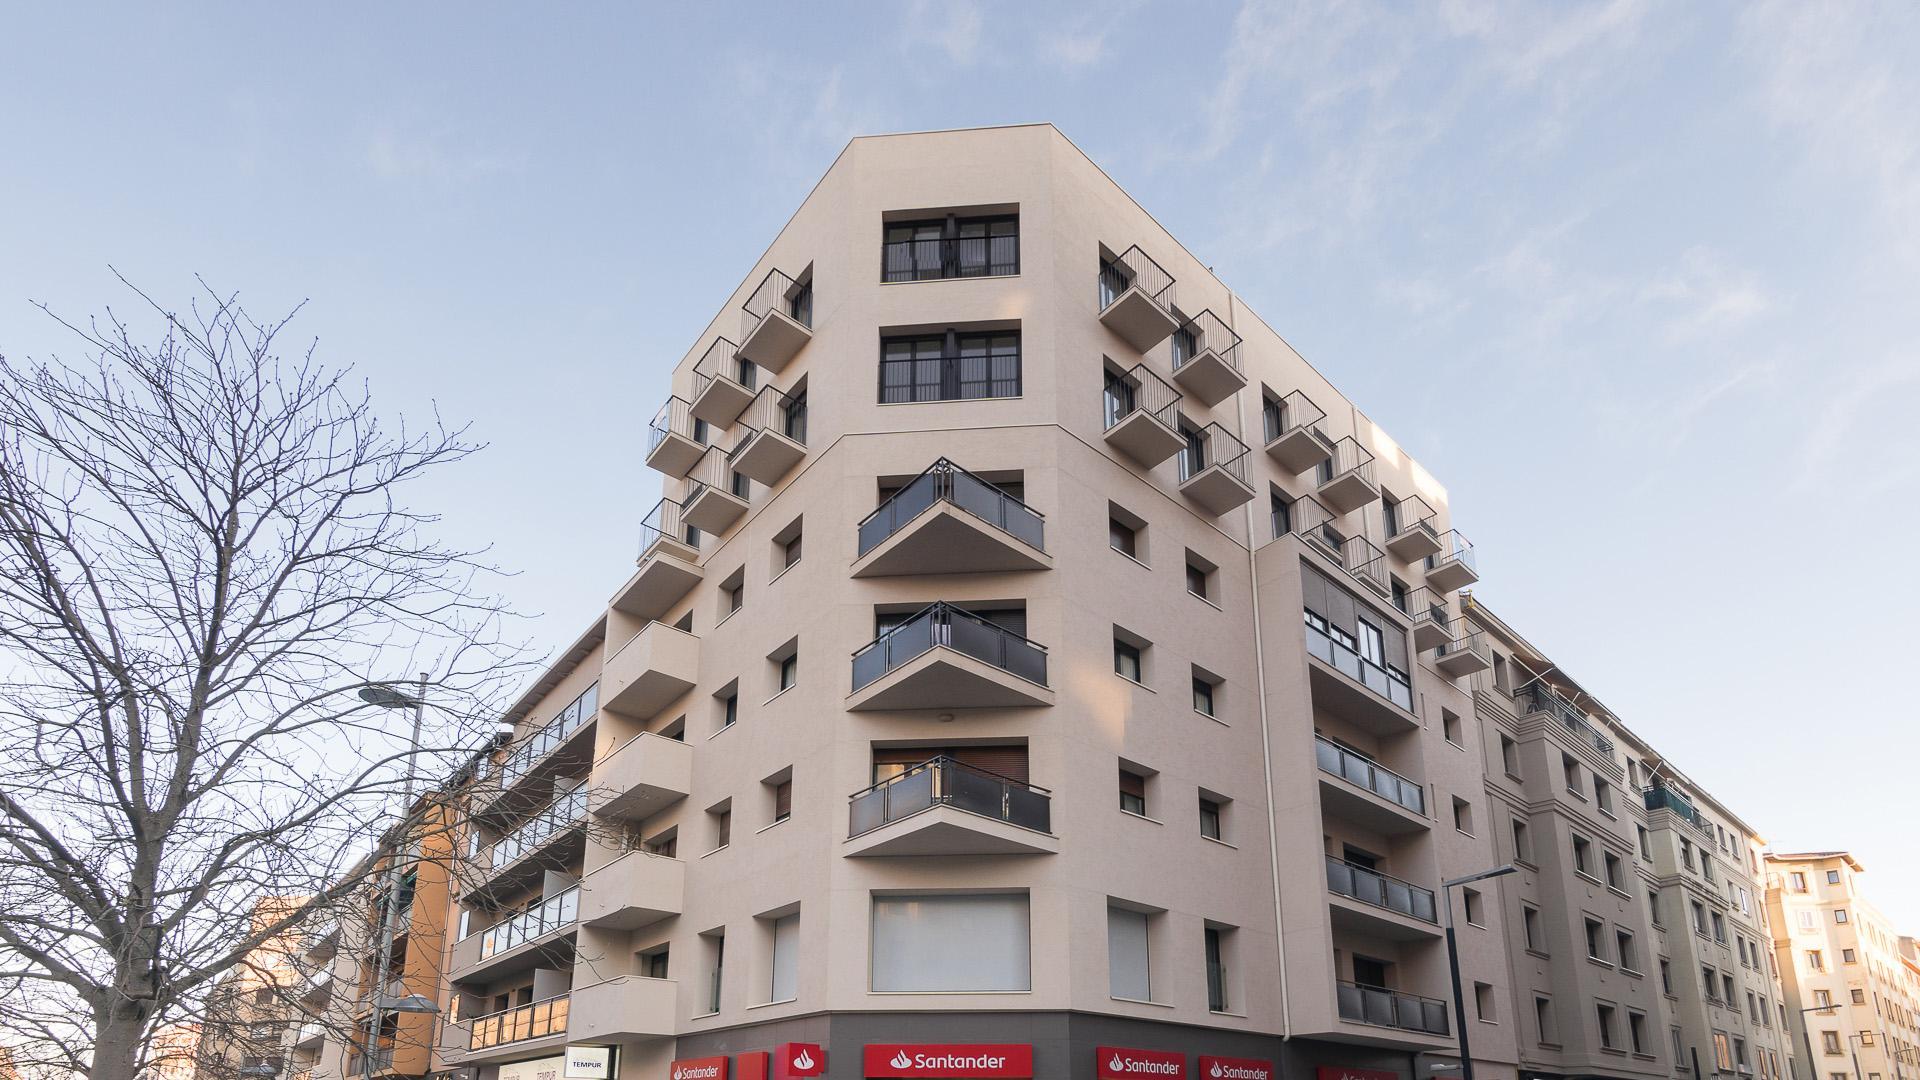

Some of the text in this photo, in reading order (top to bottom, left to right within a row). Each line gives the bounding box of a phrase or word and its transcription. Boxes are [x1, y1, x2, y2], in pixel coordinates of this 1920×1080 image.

[915, 1054, 1006, 1069] Santander
[1125, 1058, 1180, 1075] Santander
[683, 1066, 719, 1080] Santander
[1223, 1065, 1268, 1080] Santander
